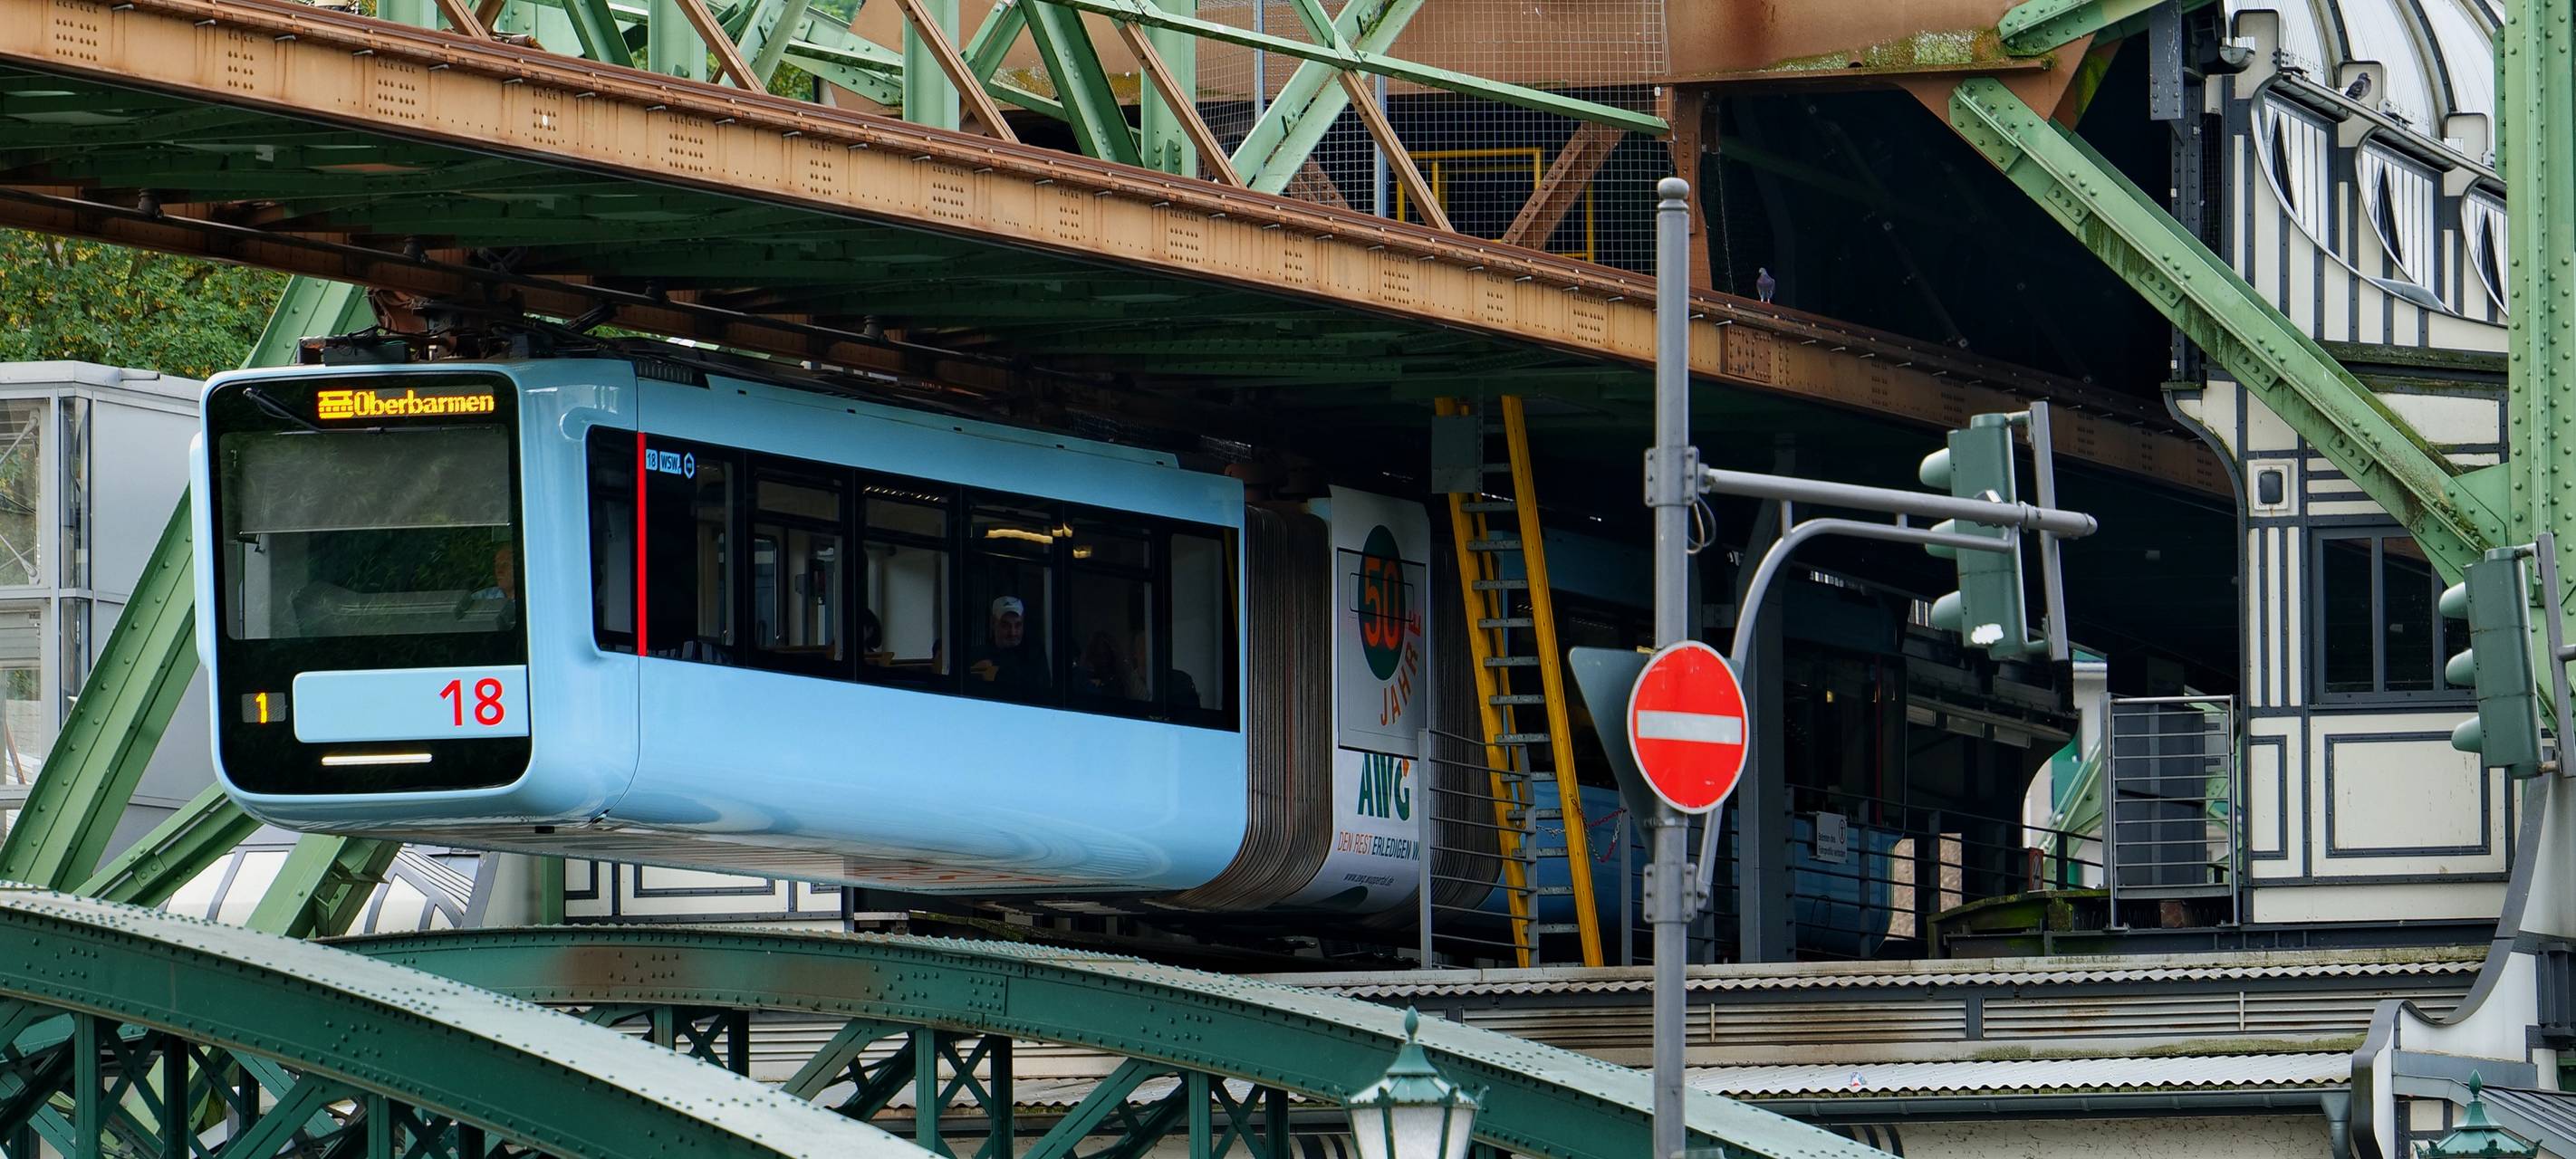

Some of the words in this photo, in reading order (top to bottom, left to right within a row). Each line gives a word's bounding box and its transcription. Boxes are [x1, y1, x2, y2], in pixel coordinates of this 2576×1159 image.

[354, 390, 495, 416] Oberbarmen
[648, 453, 657, 467] 18
[1365, 556, 1400, 650] 50
[1380, 609, 1421, 726] JAHRE
[255, 693, 267, 723] 1
[439, 677, 505, 726] 18
[1357, 752, 1410, 821] AWG
[1337, 831, 1353, 852] DEN
[1354, 833, 1373, 855] REST
[1371, 836, 1412, 860] ERLEDIGEN
